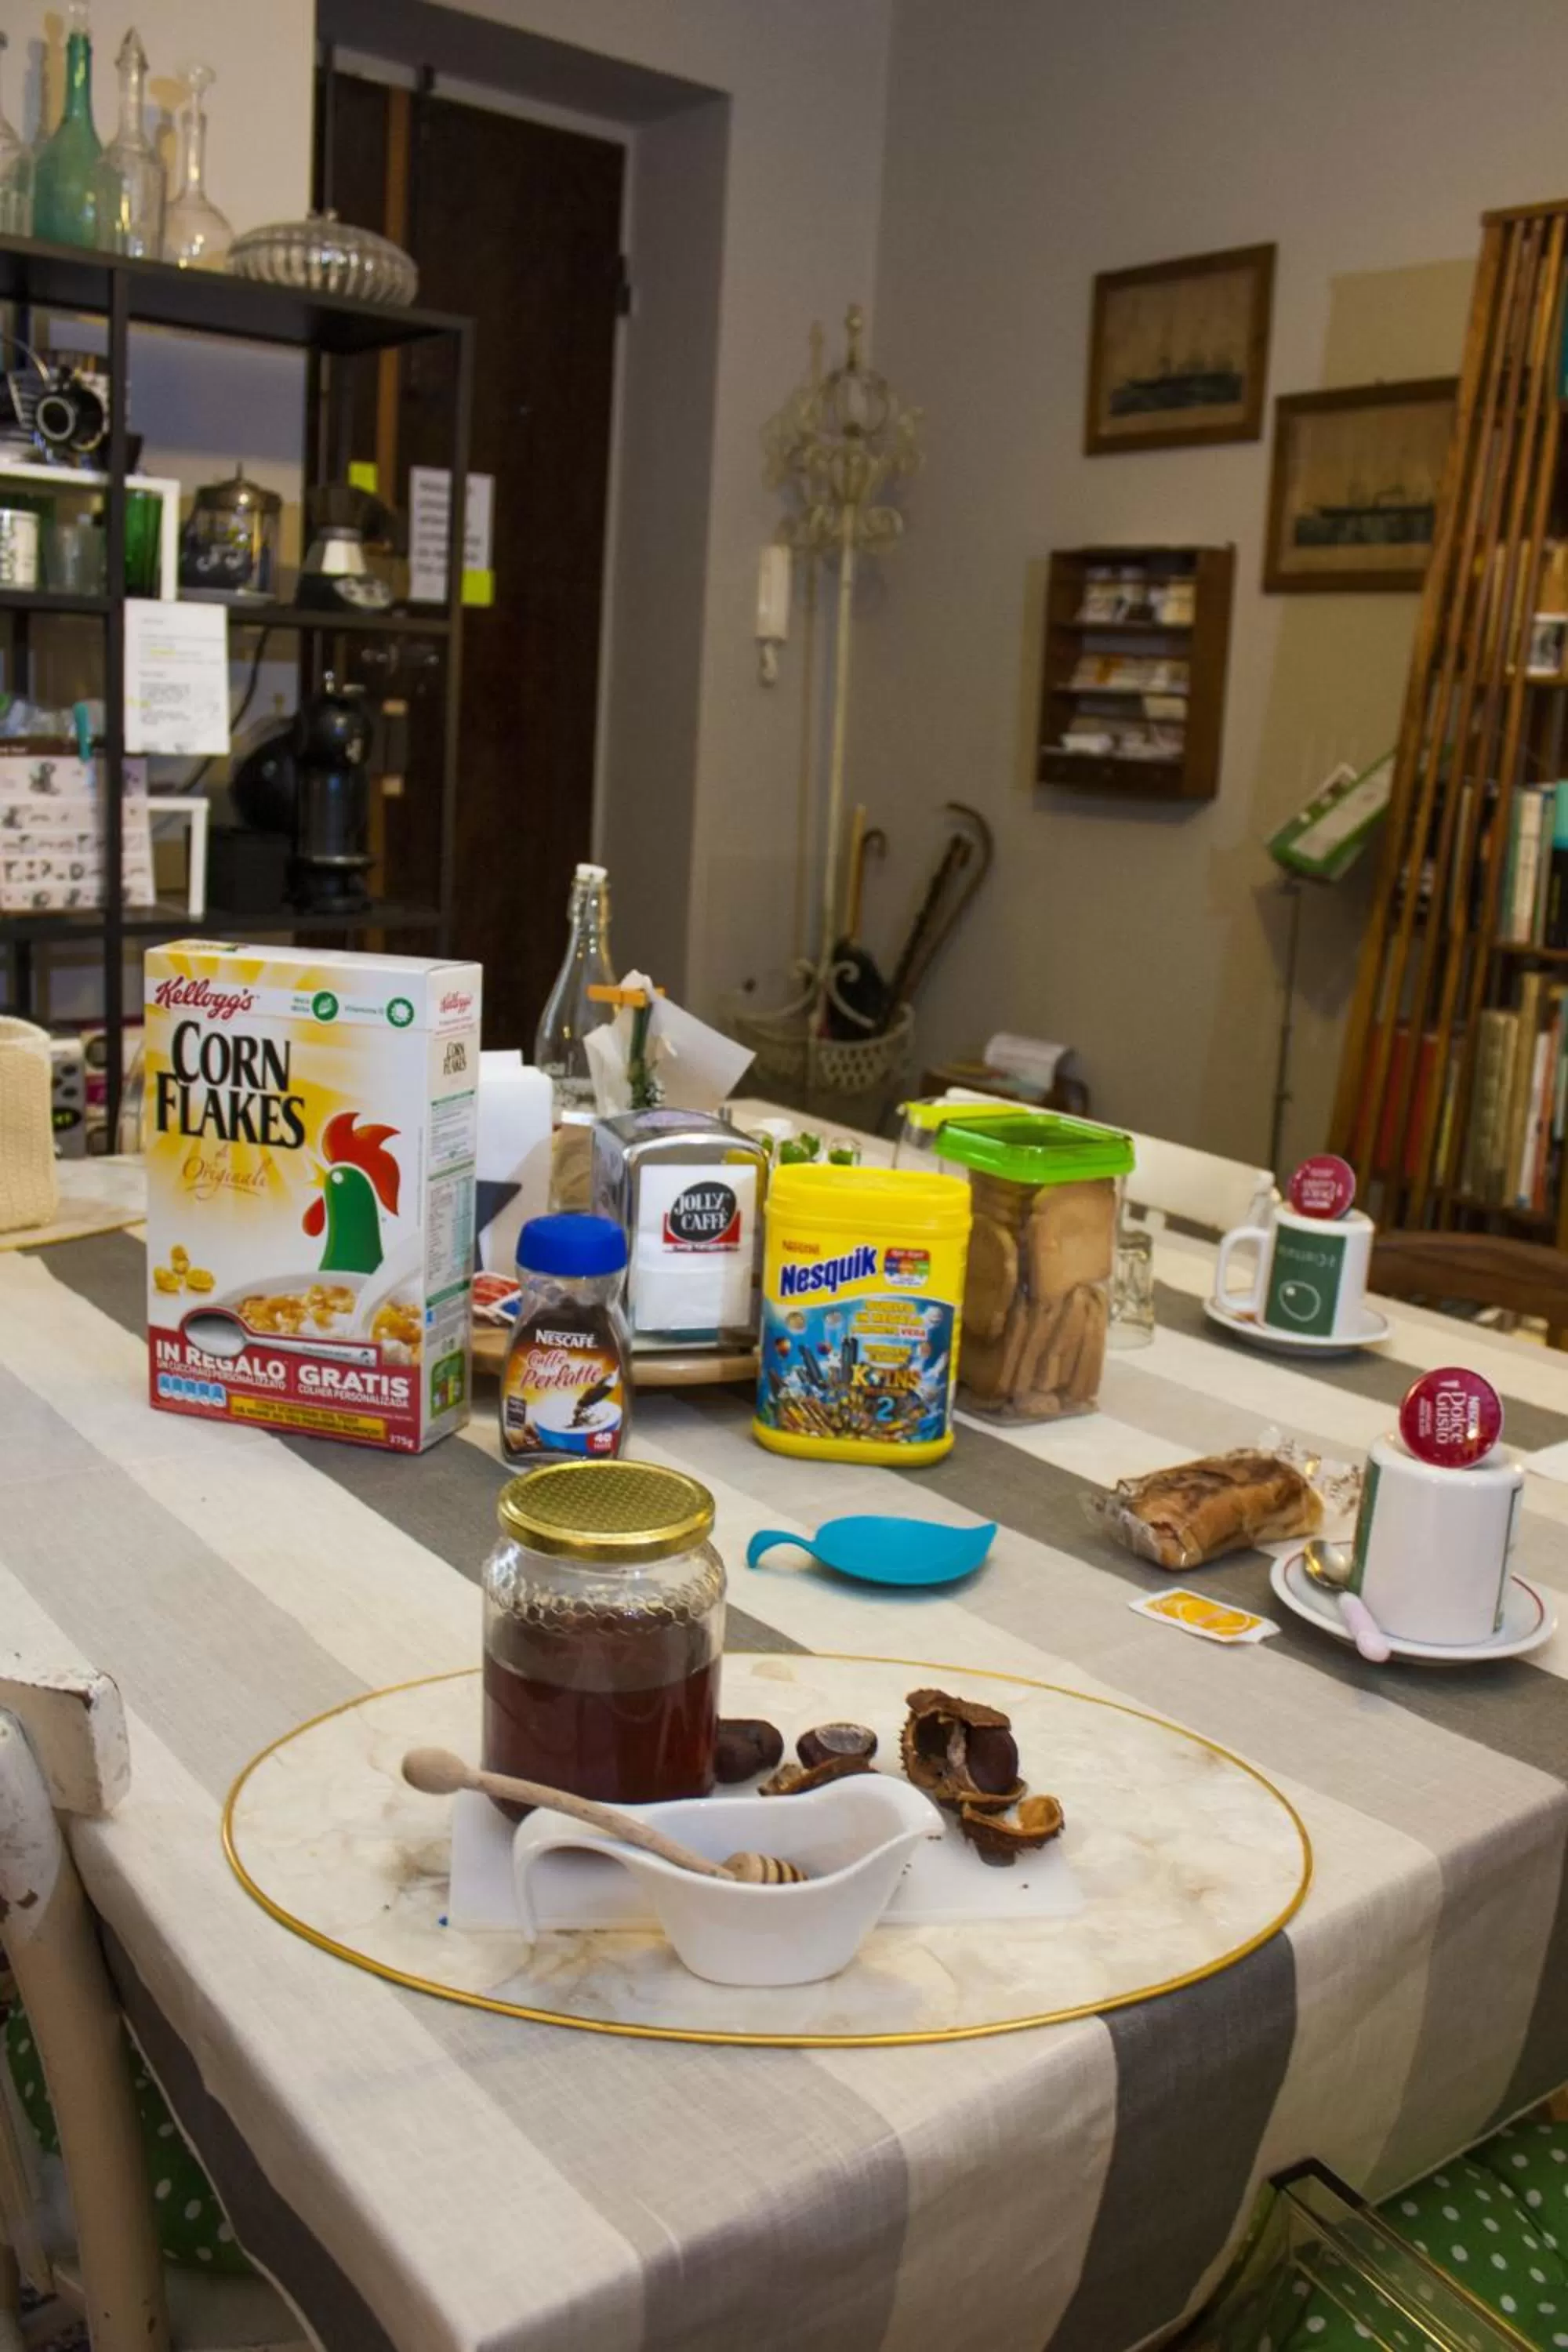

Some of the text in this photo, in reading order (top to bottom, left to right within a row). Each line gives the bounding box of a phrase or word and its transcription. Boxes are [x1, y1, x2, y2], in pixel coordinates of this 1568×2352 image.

[155, 975, 255, 1020] Kellogg's
[172, 1020, 291, 1091] CORN
[155, 1071, 305, 1149] FLAKES
[674, 1192, 724, 1215] JOLLY
[780, 1246, 877, 1297] Nesquik
[156, 1340, 285, 1381] IN REGALO
[535, 1329, 595, 1348] NESCAFÉ
[299, 1364, 408, 1398] GRATIS
[877, 1396, 895, 1421] 2
[1436, 1392, 1450, 1444] Gusto
[1451, 1392, 1467, 1443] Dolce
